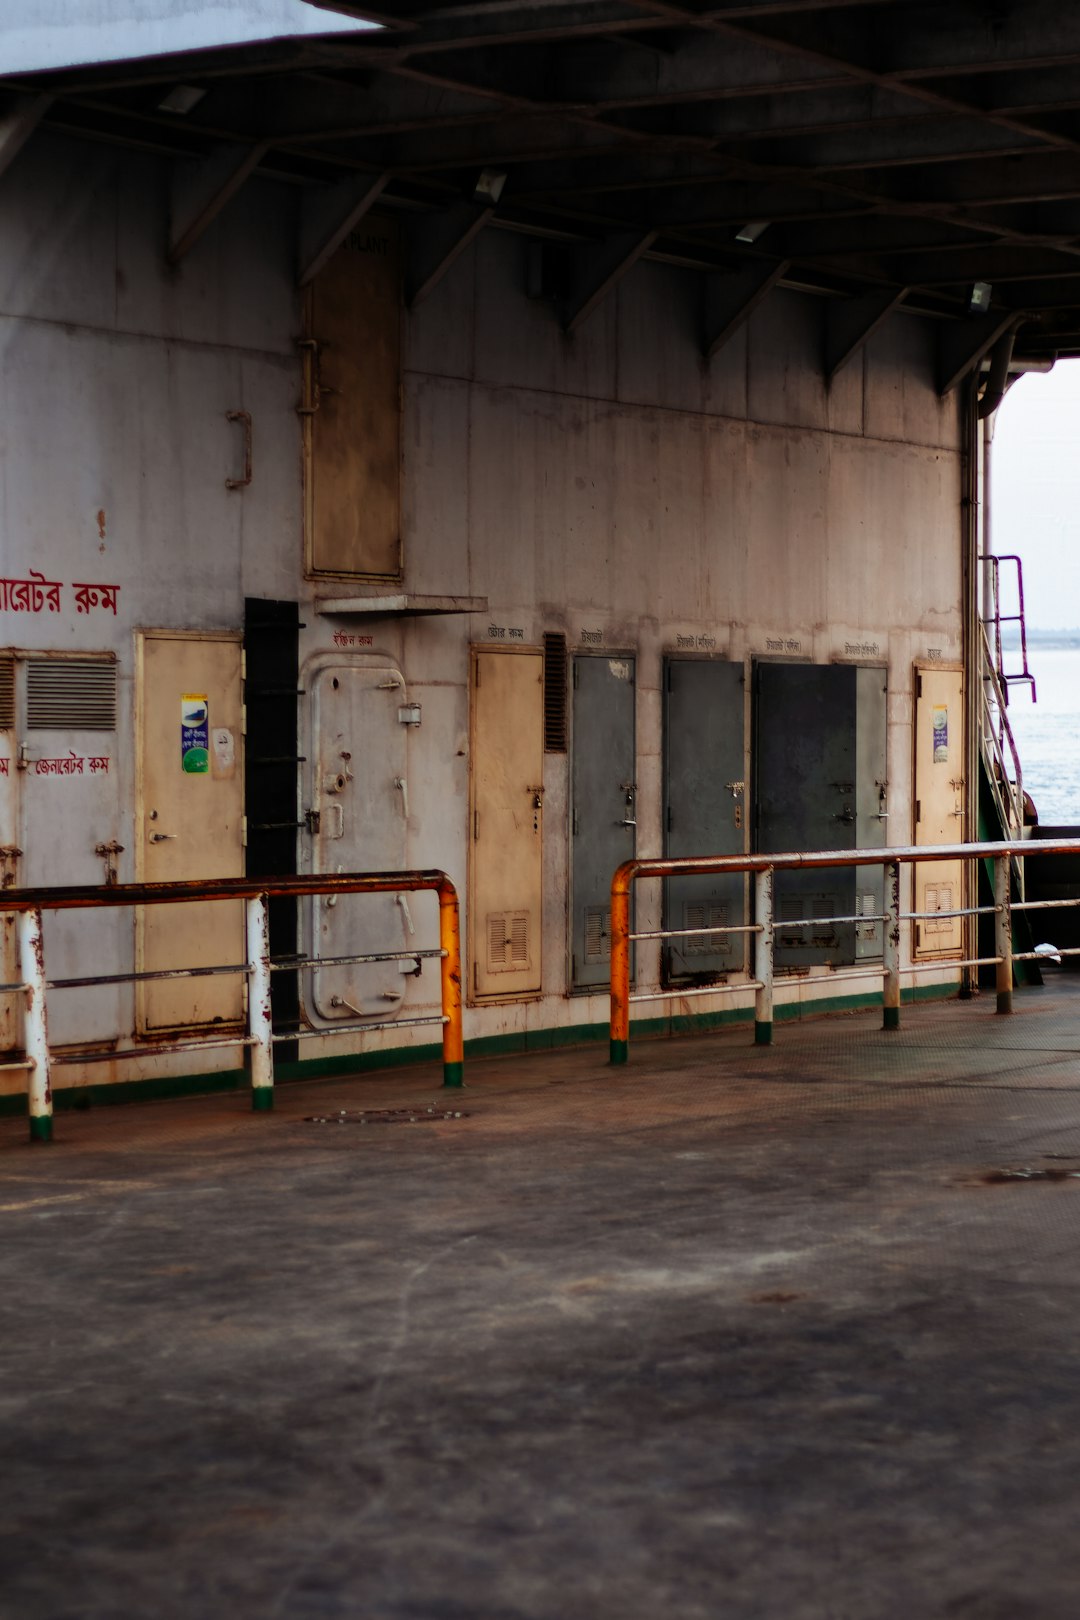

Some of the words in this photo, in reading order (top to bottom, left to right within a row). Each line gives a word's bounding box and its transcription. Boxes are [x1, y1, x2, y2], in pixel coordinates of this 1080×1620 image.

[350, 231, 388, 256] PLANT
[0, 568, 63, 612] ারেটর
[72, 583, 121, 616] রুম
[358, 635, 373, 647] রুম
[508, 628, 524, 640] রুম
[35, 749, 85, 775] জেনারেটর
[88, 757, 110, 774] রুম
